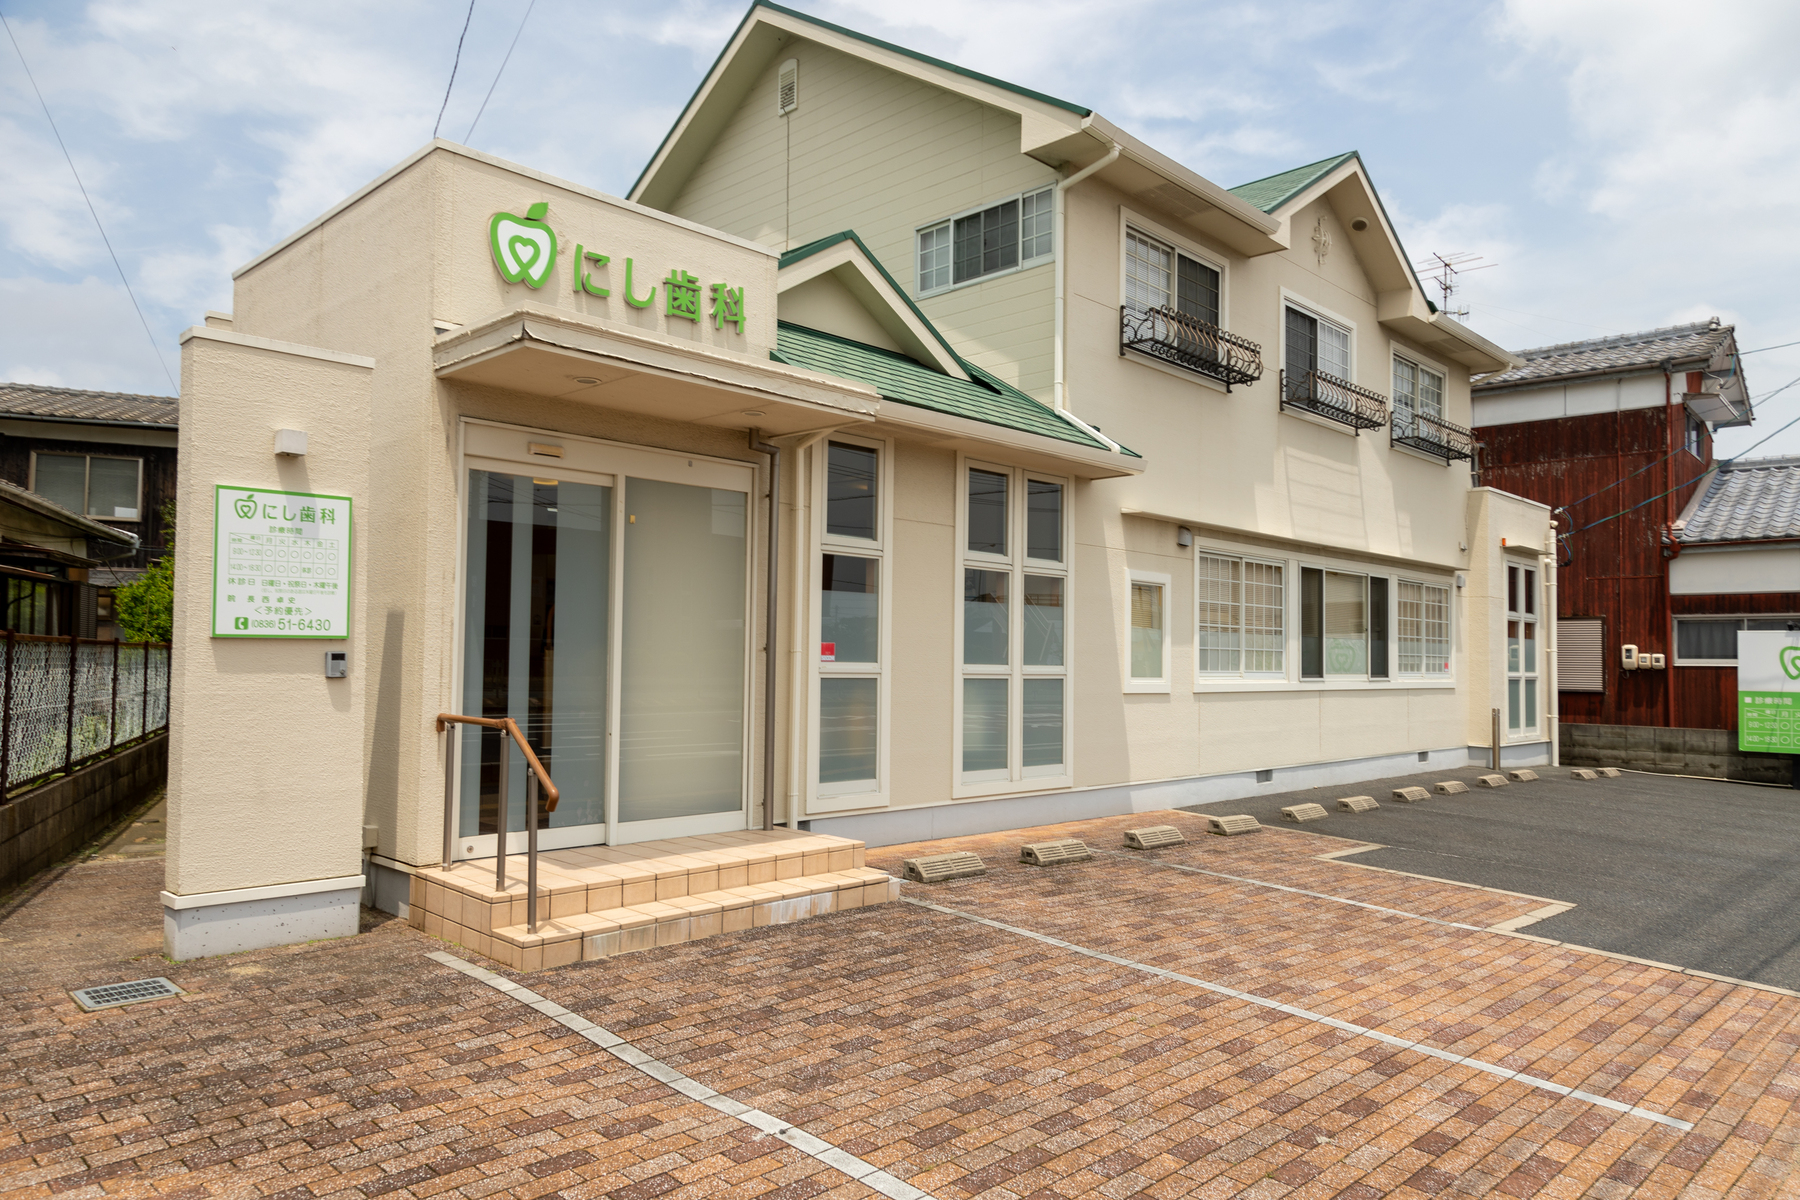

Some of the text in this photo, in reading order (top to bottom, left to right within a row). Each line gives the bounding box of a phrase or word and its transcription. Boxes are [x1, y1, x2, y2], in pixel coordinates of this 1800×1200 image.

[573, 243, 747, 334] にし歯科
[262, 503, 336, 525] にし歯科
[227, 577, 256, 586] 休診日
